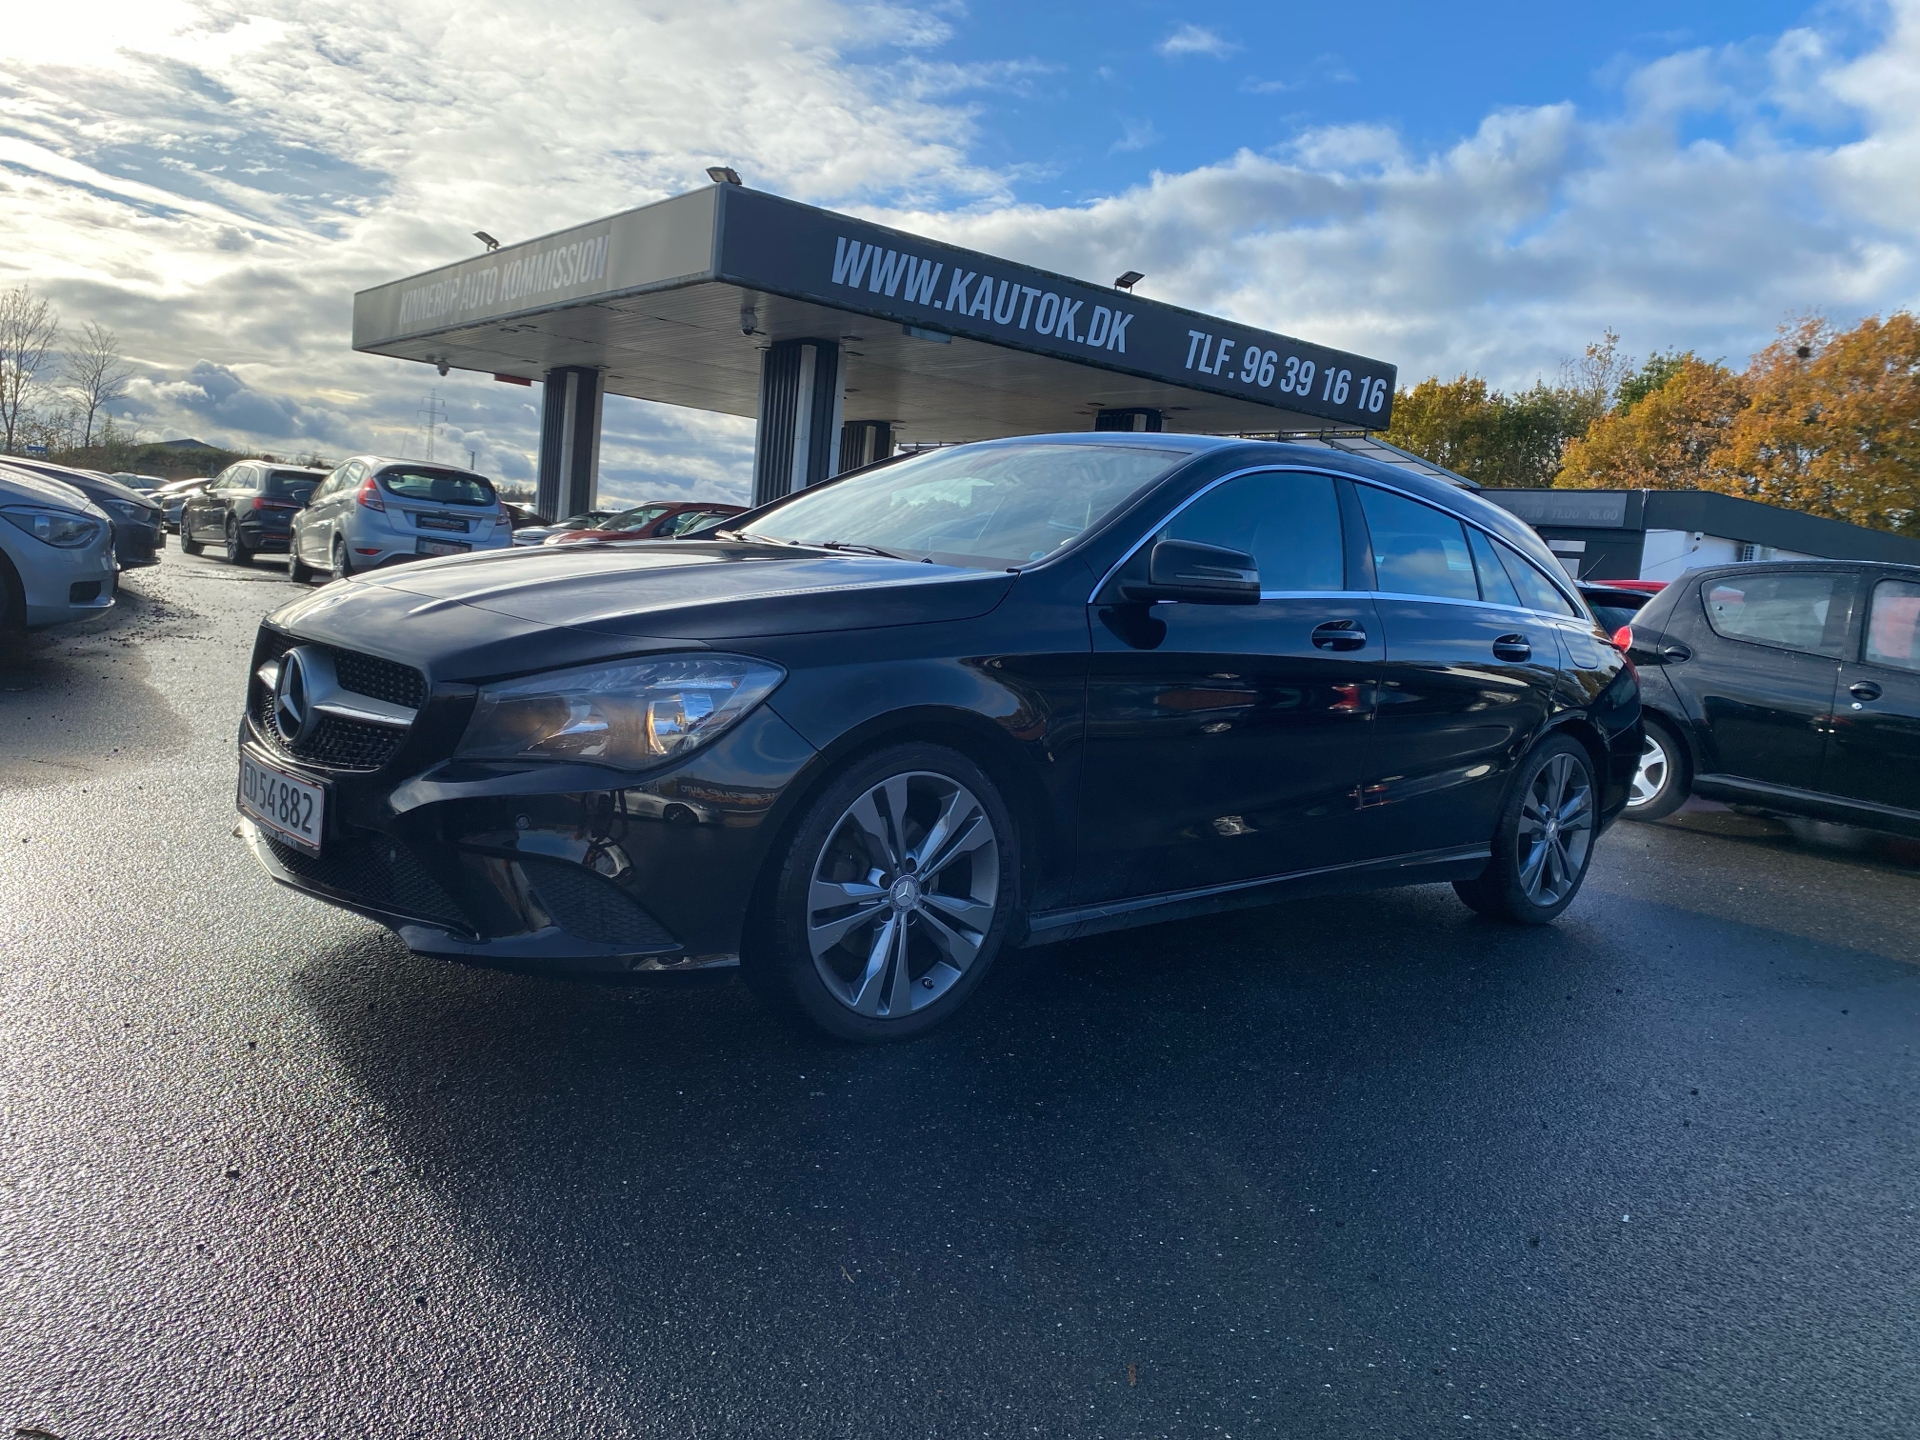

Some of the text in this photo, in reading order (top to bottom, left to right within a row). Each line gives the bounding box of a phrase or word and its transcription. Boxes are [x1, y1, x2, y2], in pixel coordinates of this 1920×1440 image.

[399, 235, 609, 325] KINNERUP AUTO KOMMISSION
[831, 236, 1135, 354] WWW.KAUTOK.DK
[1185, 329, 1387, 413] TLF. 96 39 16 16
[1588, 509, 1619, 521] 16.00
[243, 761, 313, 834] ED 54 882
